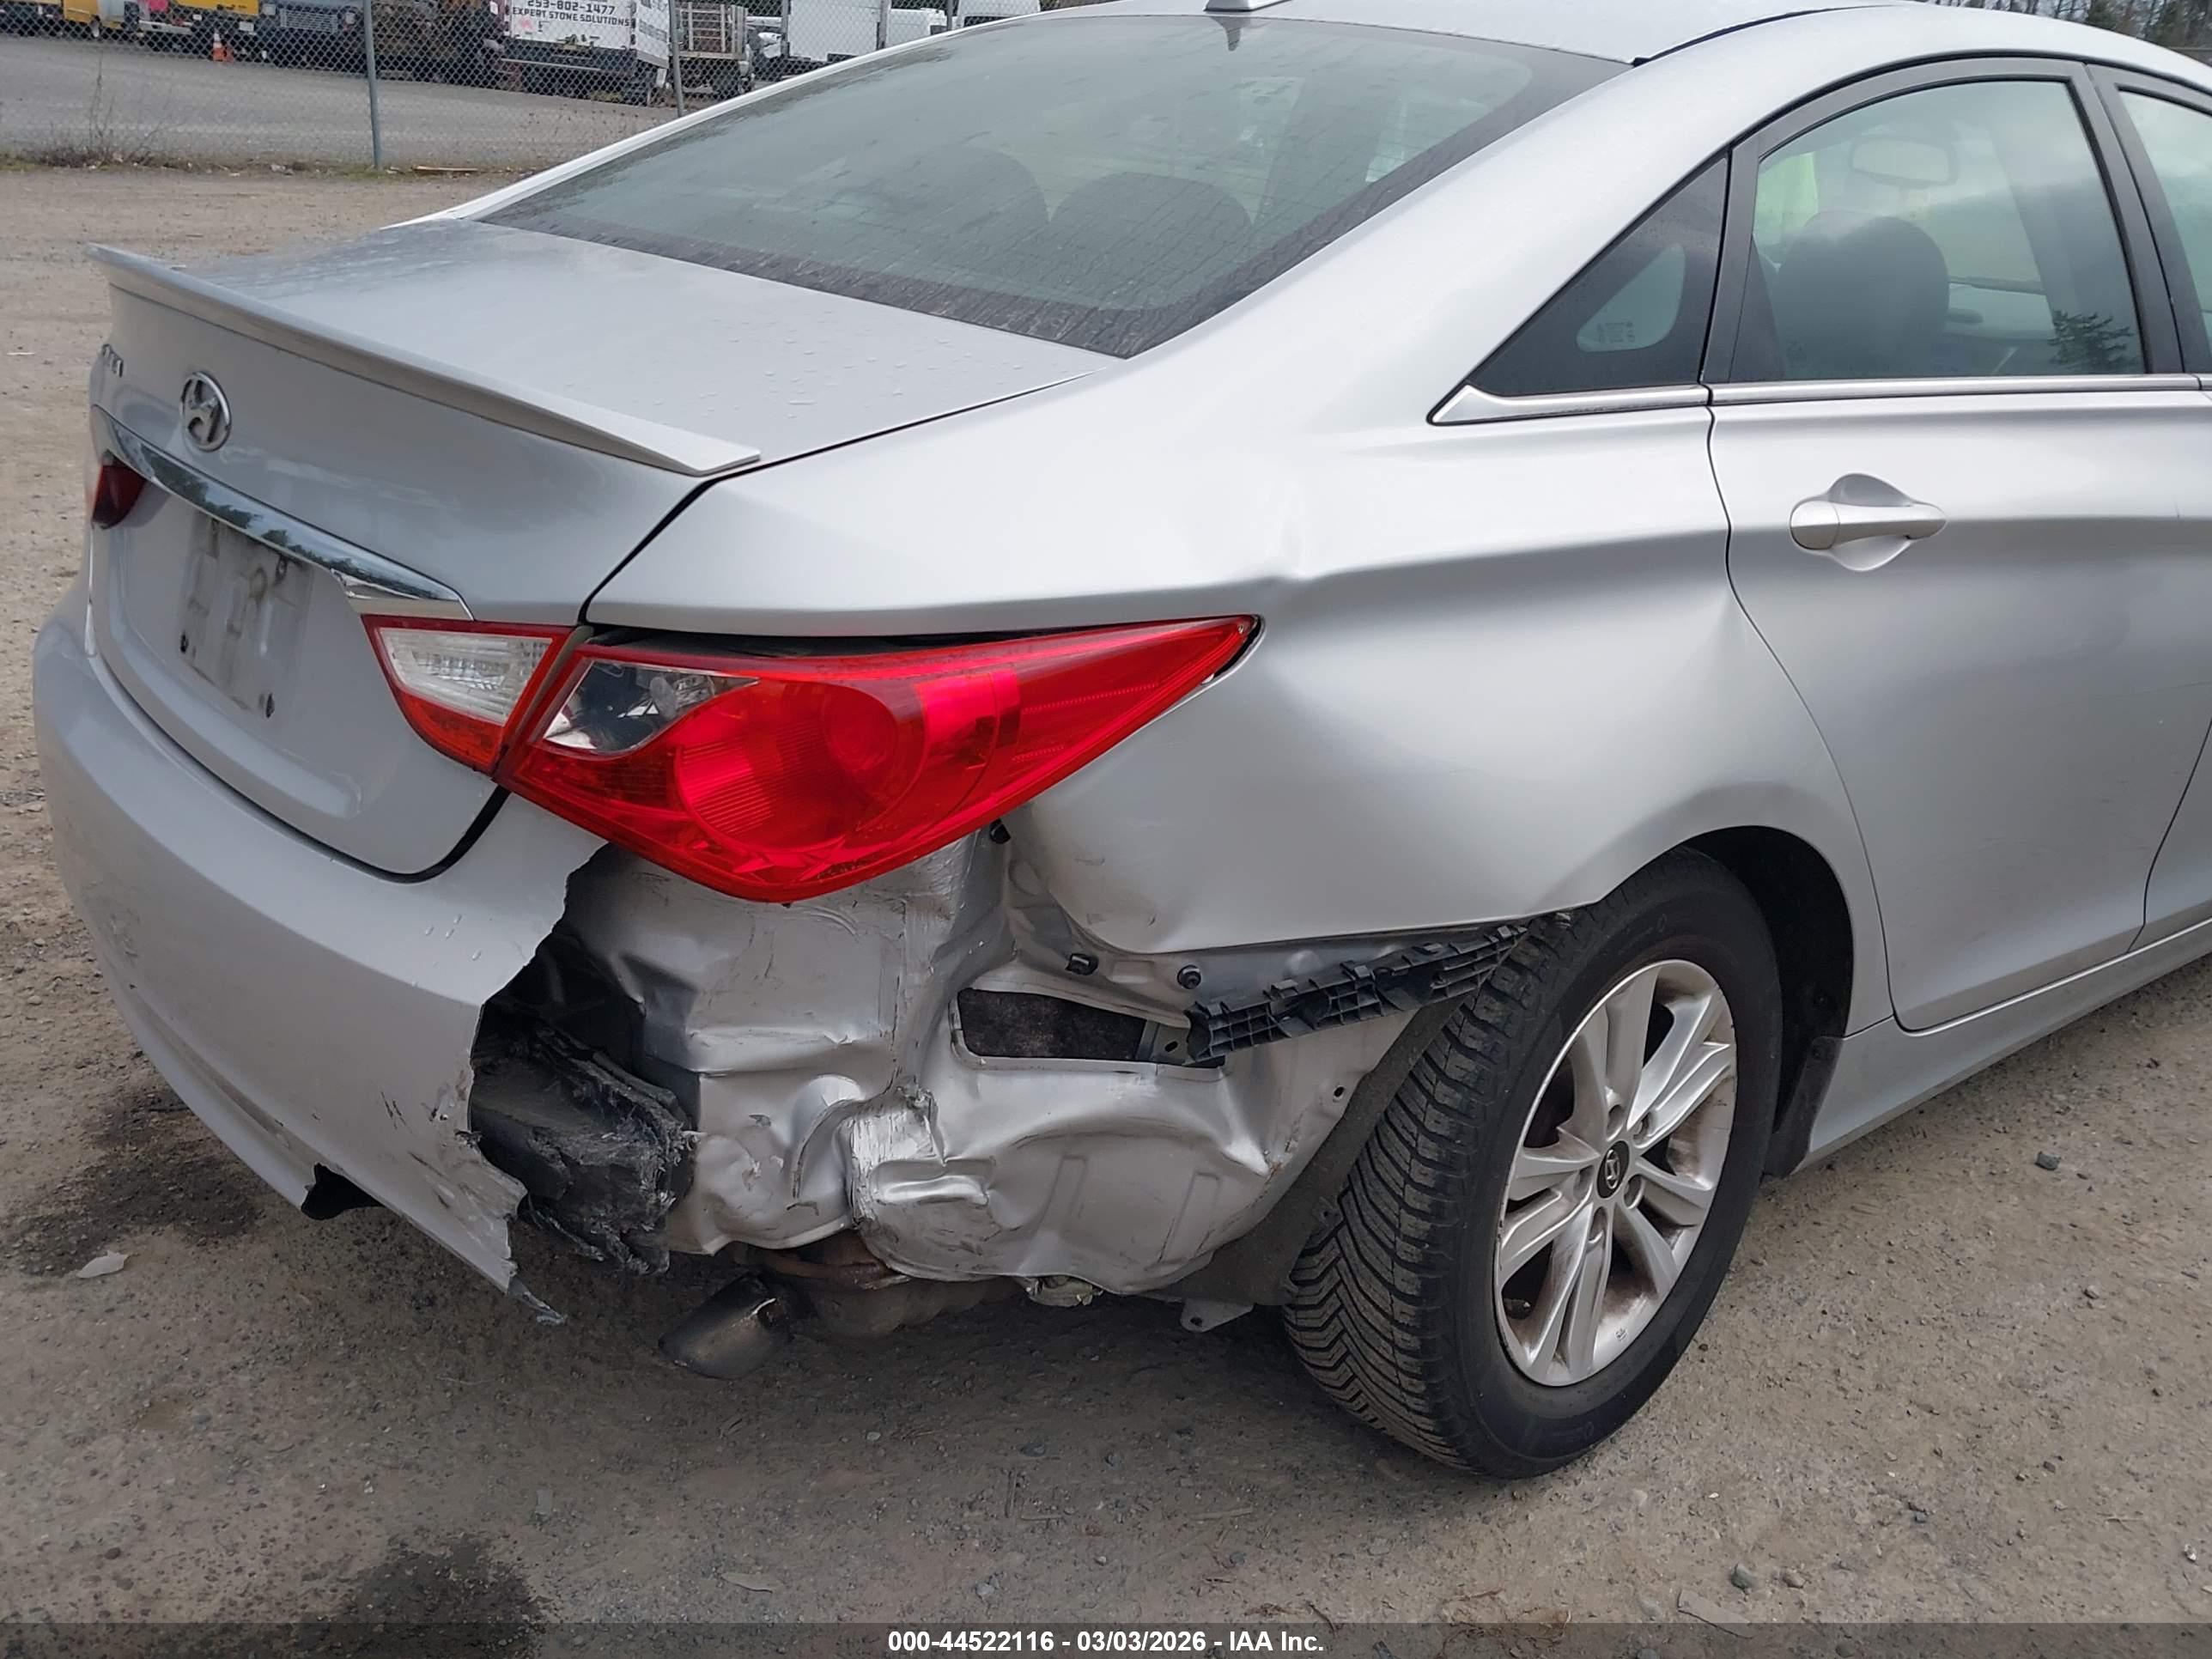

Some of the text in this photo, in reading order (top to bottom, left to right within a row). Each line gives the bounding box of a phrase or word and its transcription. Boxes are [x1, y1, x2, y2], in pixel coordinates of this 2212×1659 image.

[527, 0, 616, 15] 253-802-1477
[513, 7, 629, 27] EXPERT STONE SOLUTIONS
